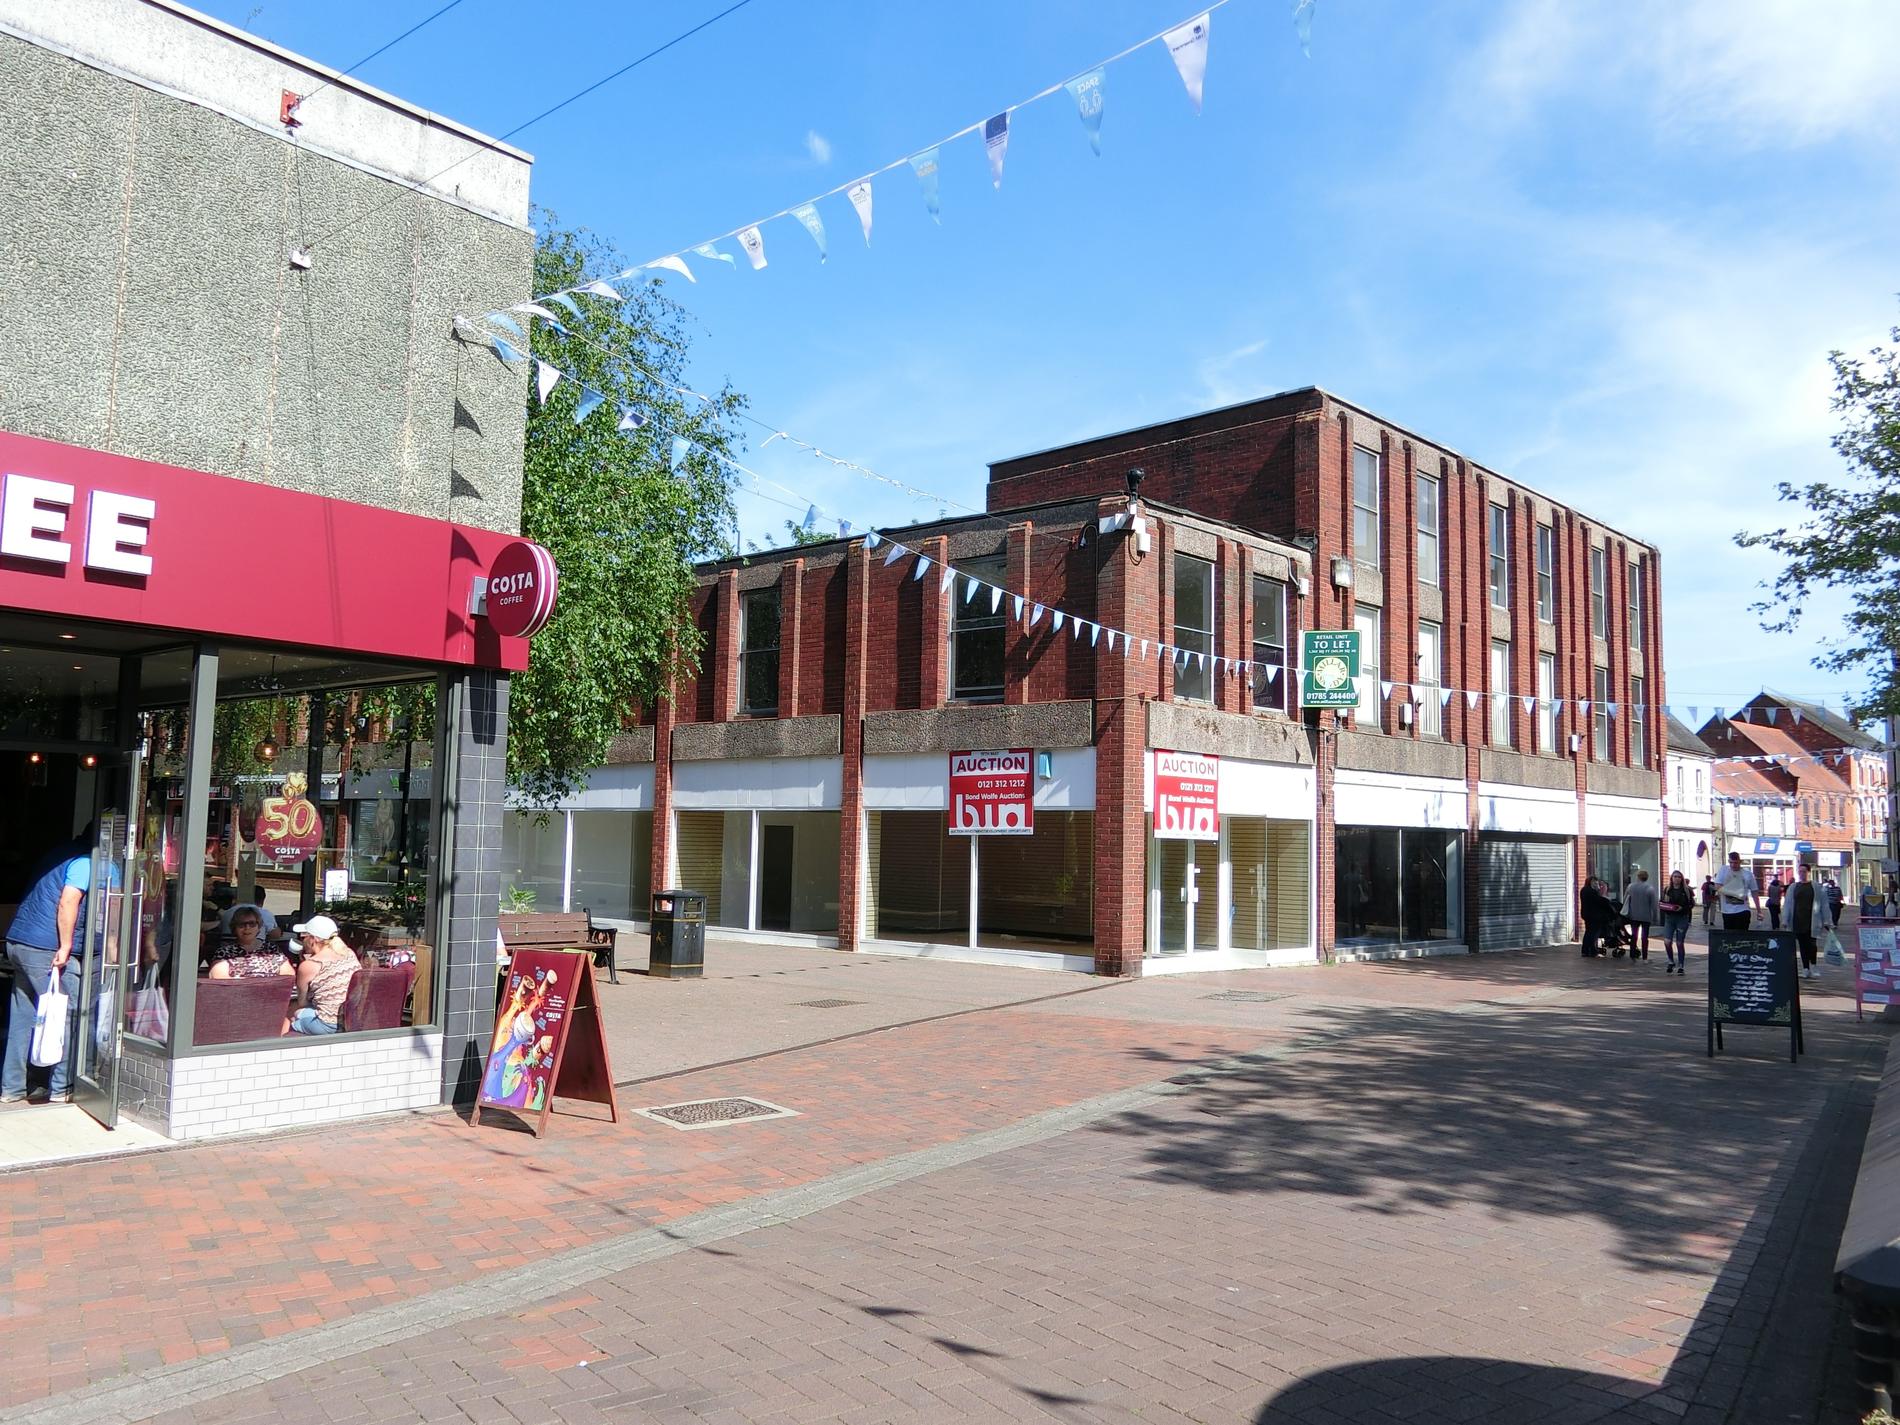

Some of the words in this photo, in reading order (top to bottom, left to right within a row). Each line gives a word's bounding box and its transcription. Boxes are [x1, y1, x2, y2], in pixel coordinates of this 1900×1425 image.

[491, 571, 534, 594] COSTA
[500, 595, 523, 605] COFFEE
[1314, 640, 1329, 649] TO
[1333, 640, 1351, 649] LET
[1317, 659, 1346, 675] MILLAR
[956, 757, 1025, 772] AUCTION
[1162, 758, 1215, 775] AUCTION
[977, 780, 993, 788] 0121
[995, 780, 1007, 788] 312
[1009, 779, 1025, 787] 1212
[262, 797, 318, 840] 50
[275, 847, 301, 855] COSTA
